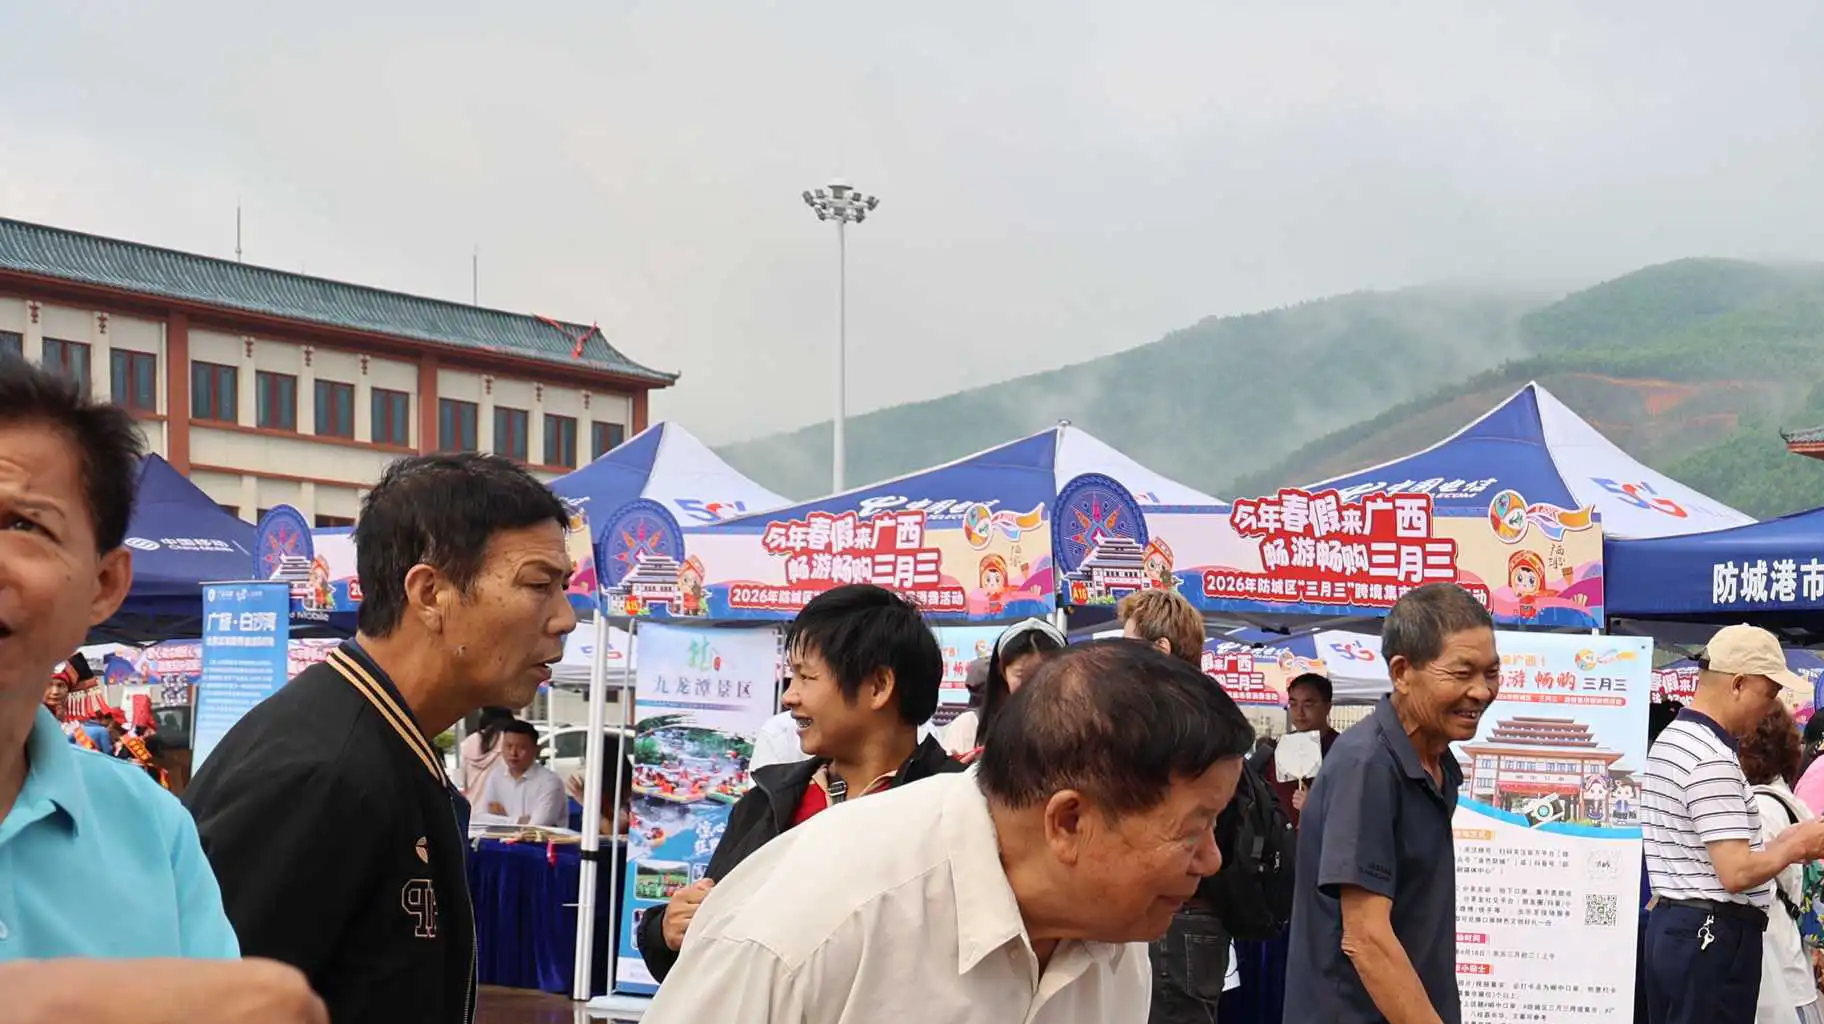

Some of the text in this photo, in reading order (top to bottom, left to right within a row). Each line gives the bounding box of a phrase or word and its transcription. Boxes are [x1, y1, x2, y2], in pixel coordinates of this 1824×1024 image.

[766, 513, 922, 552] 今年春假来广西
[1234, 492, 1428, 538] 今年春假来广西
[788, 552, 939, 587] 畅游畅购三月三
[1263, 536, 1456, 582] 畅游畅购三月三
[1207, 573, 1488, 605] 2026年防城区“三月三”跨境集动
[653, 674, 753, 699] 九龙潭景区
[1583, 677, 1627, 692] 三月三
